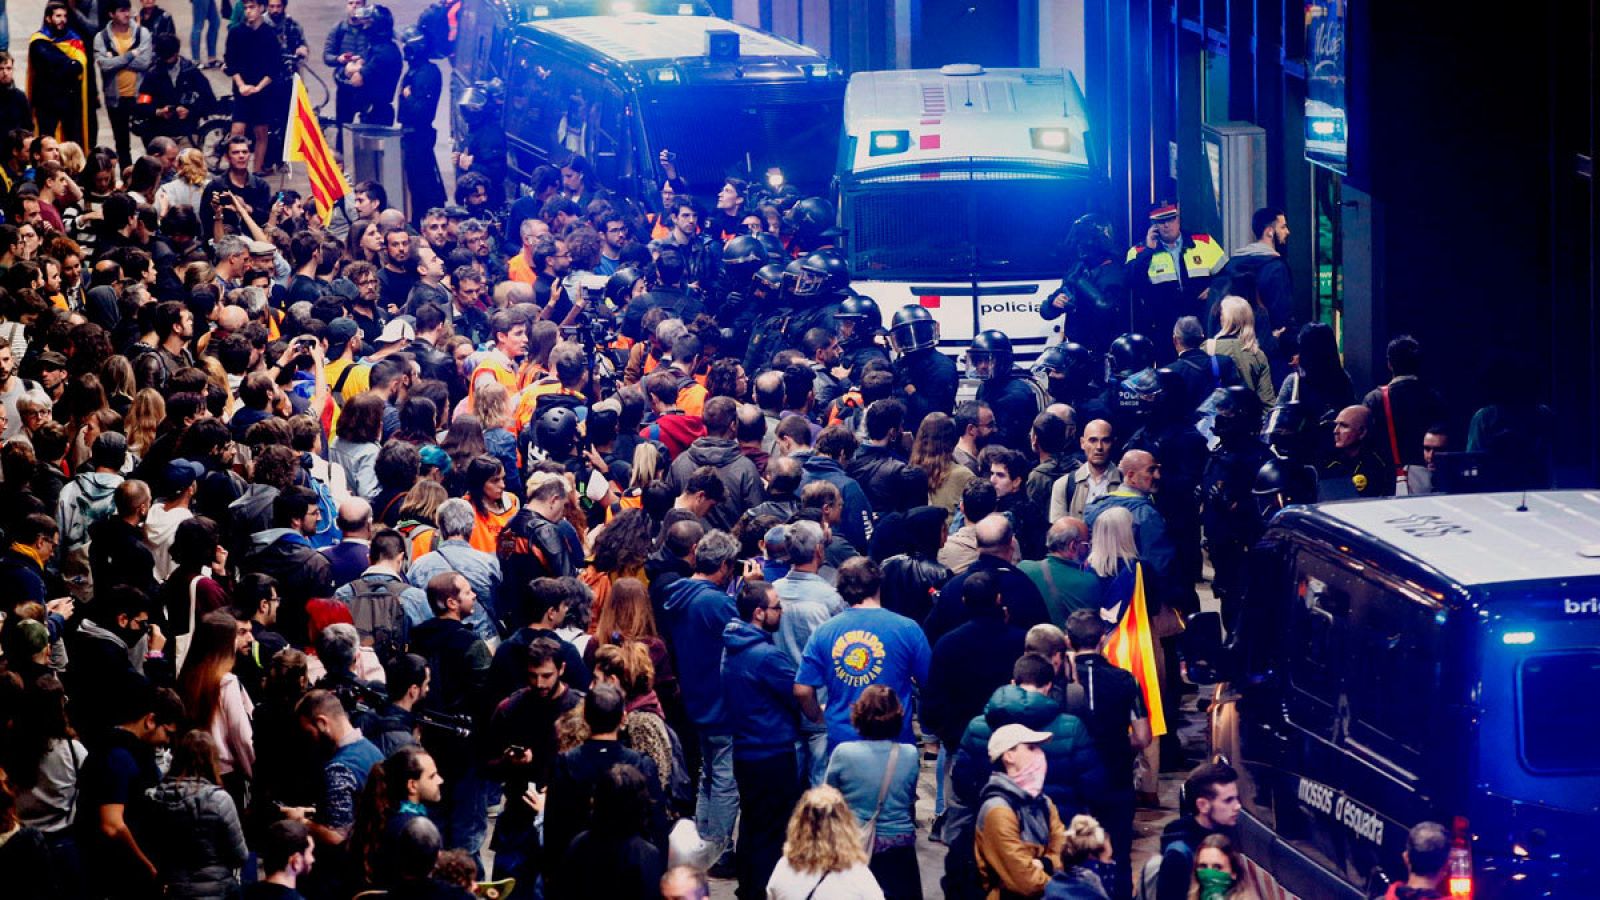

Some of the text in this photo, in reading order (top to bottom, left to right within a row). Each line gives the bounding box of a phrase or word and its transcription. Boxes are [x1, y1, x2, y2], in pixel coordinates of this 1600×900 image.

[980, 301, 1041, 316] policia
[1564, 597, 1600, 614] bri
[1298, 778, 1333, 815] mossos
